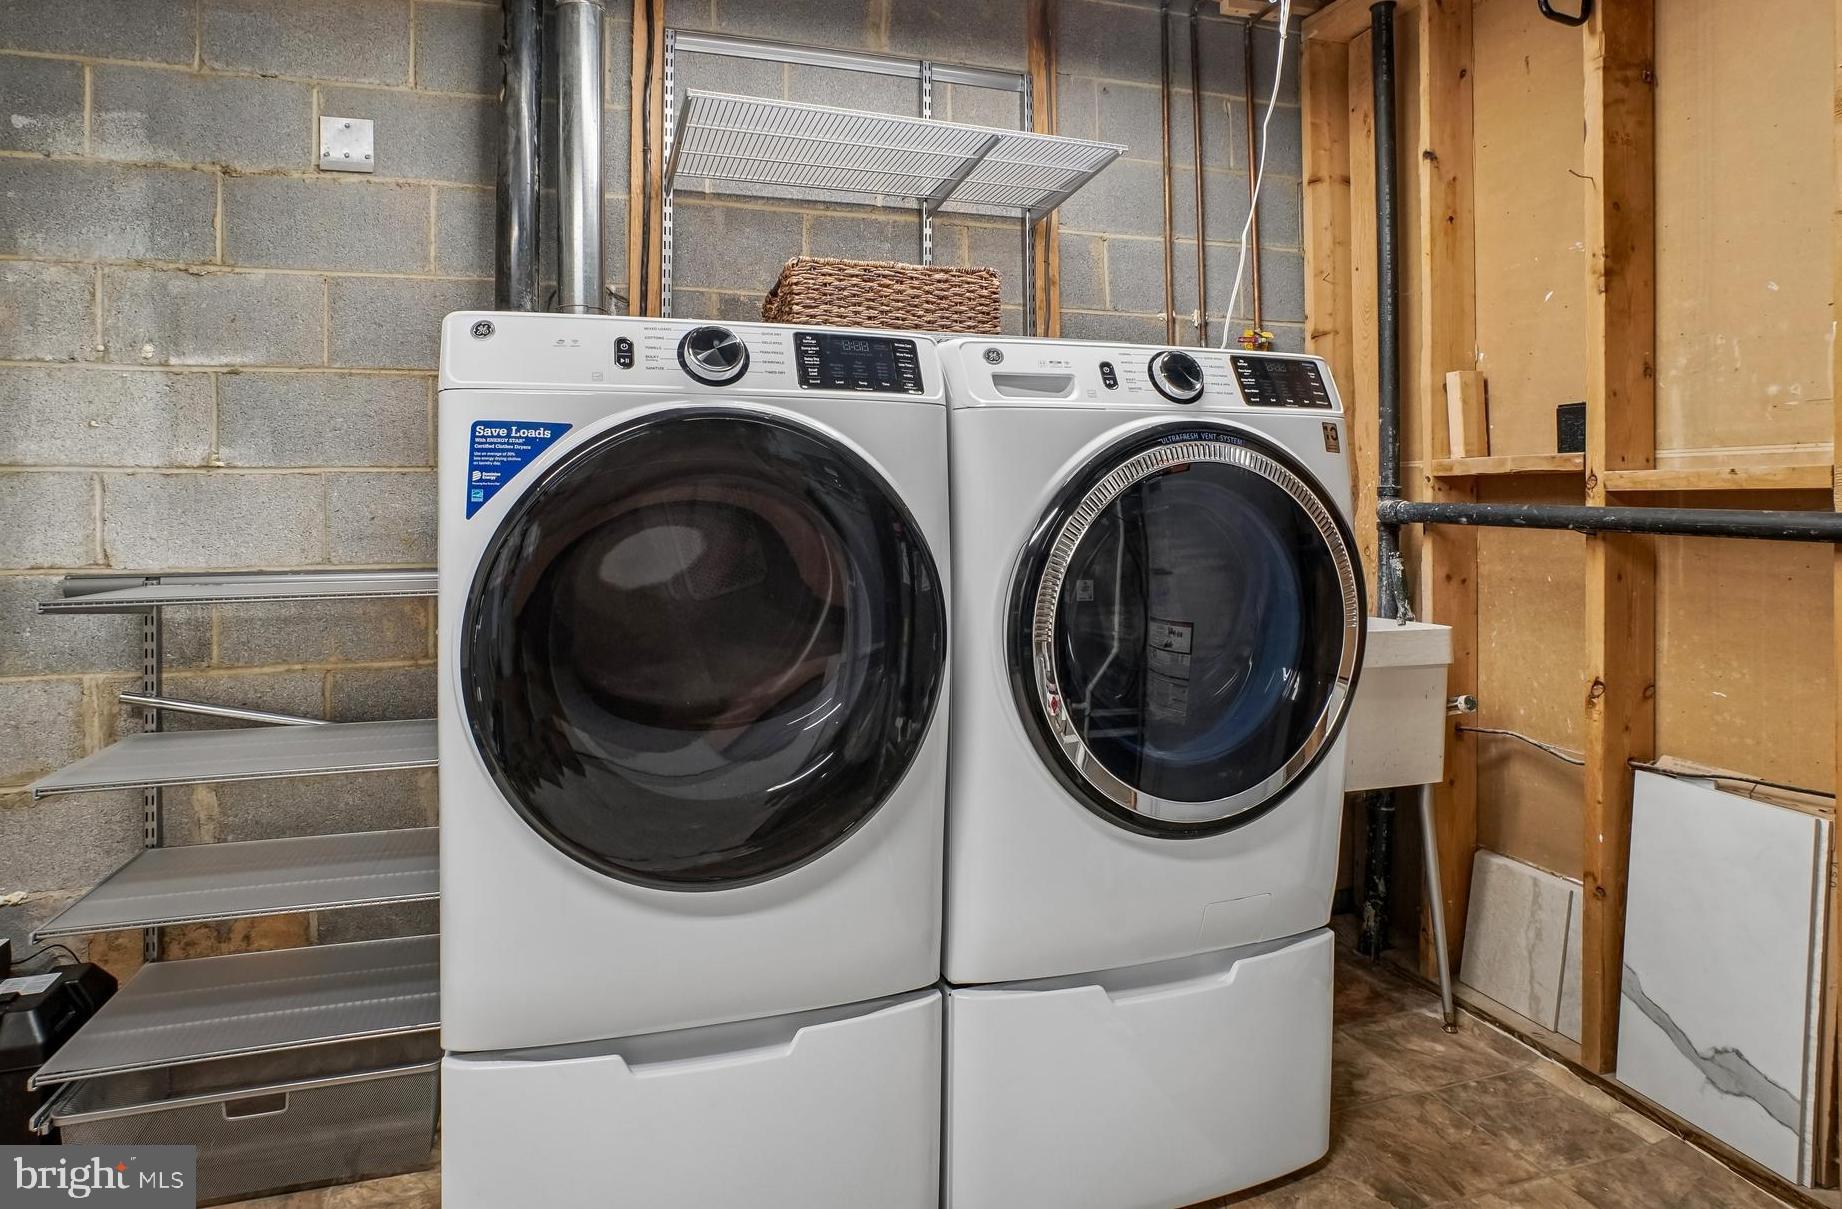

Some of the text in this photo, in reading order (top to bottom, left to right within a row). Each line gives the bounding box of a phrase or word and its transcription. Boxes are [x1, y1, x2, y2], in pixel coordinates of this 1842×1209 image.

[475, 426, 551, 438] Save Loads
[1161, 432, 1198, 445] ULTRAFRESH
[1220, 434, 1243, 445] SYSTEM
